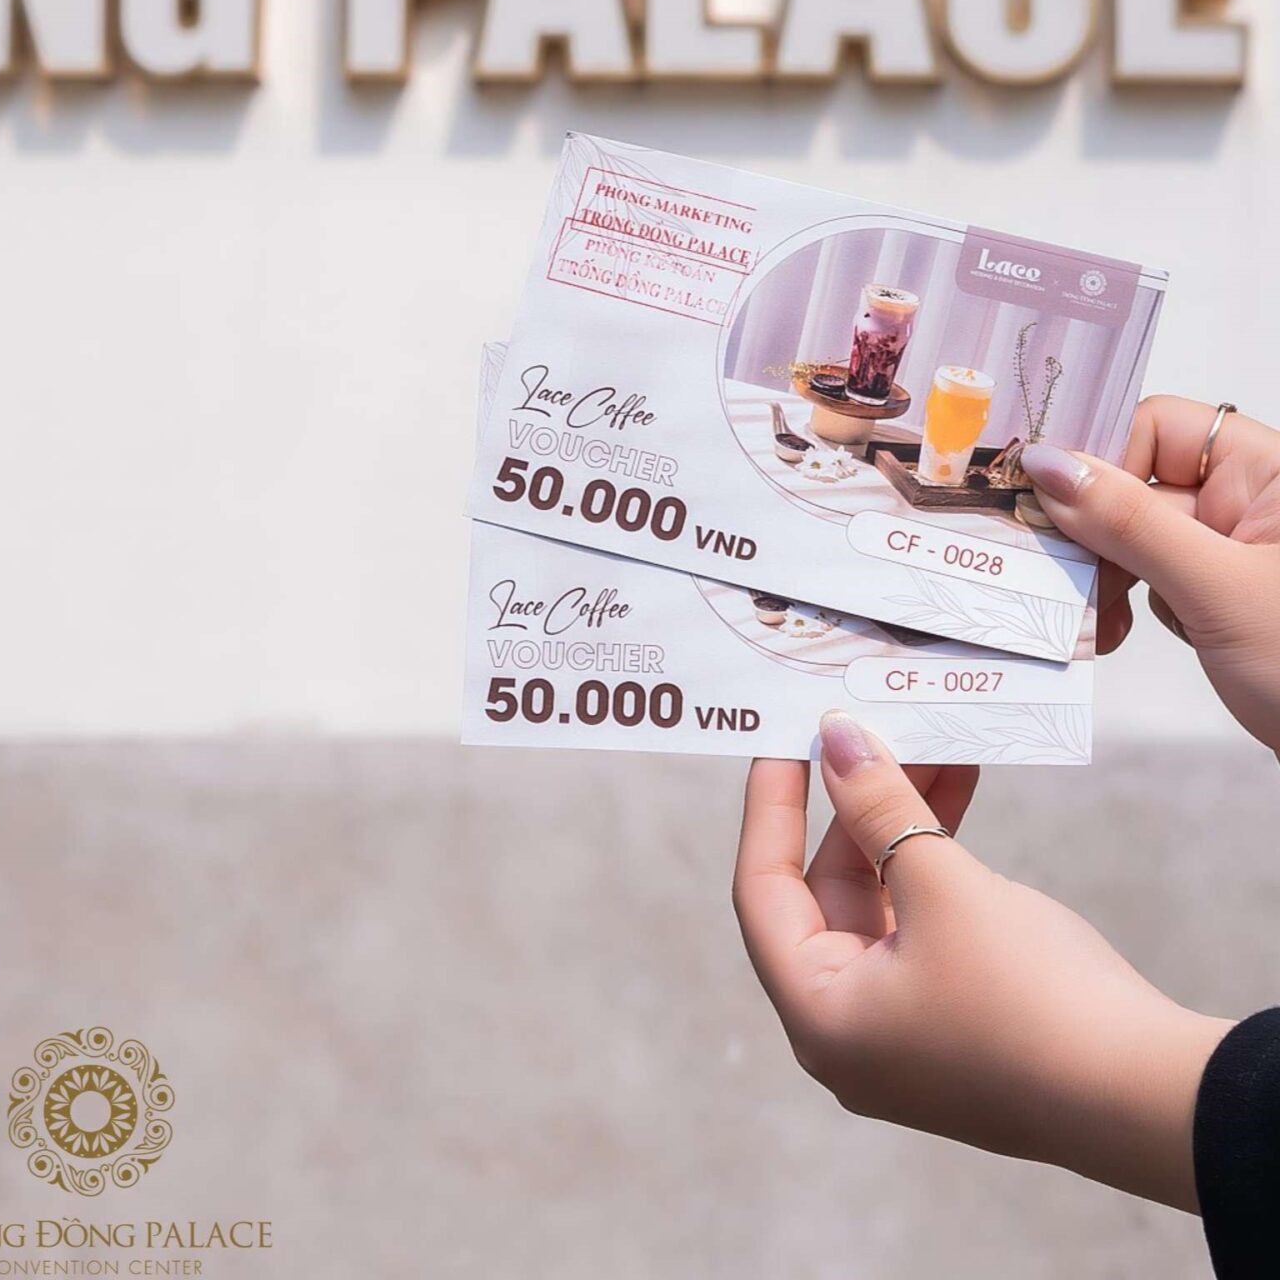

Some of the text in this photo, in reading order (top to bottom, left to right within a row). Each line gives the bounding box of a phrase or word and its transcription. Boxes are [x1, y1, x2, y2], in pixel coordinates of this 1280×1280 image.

[653, 198, 753, 234] MARKETING
[687, 236, 751, 266] PALACE
[512, 364, 658, 431] Lace Coffee
[508, 418, 679, 487] VOUCHER
[492, 456, 758, 561] 50.000 VND
[887, 530, 922, 554] CF
[943, 544, 1004, 576] 0028
[488, 579, 633, 636] Lace Coffee
[486, 639, 665, 674] VOUCHER
[885, 670, 919, 691] CF
[943, 672, 1004, 692] 0027
[484, 676, 761, 732] 50.000 VND
